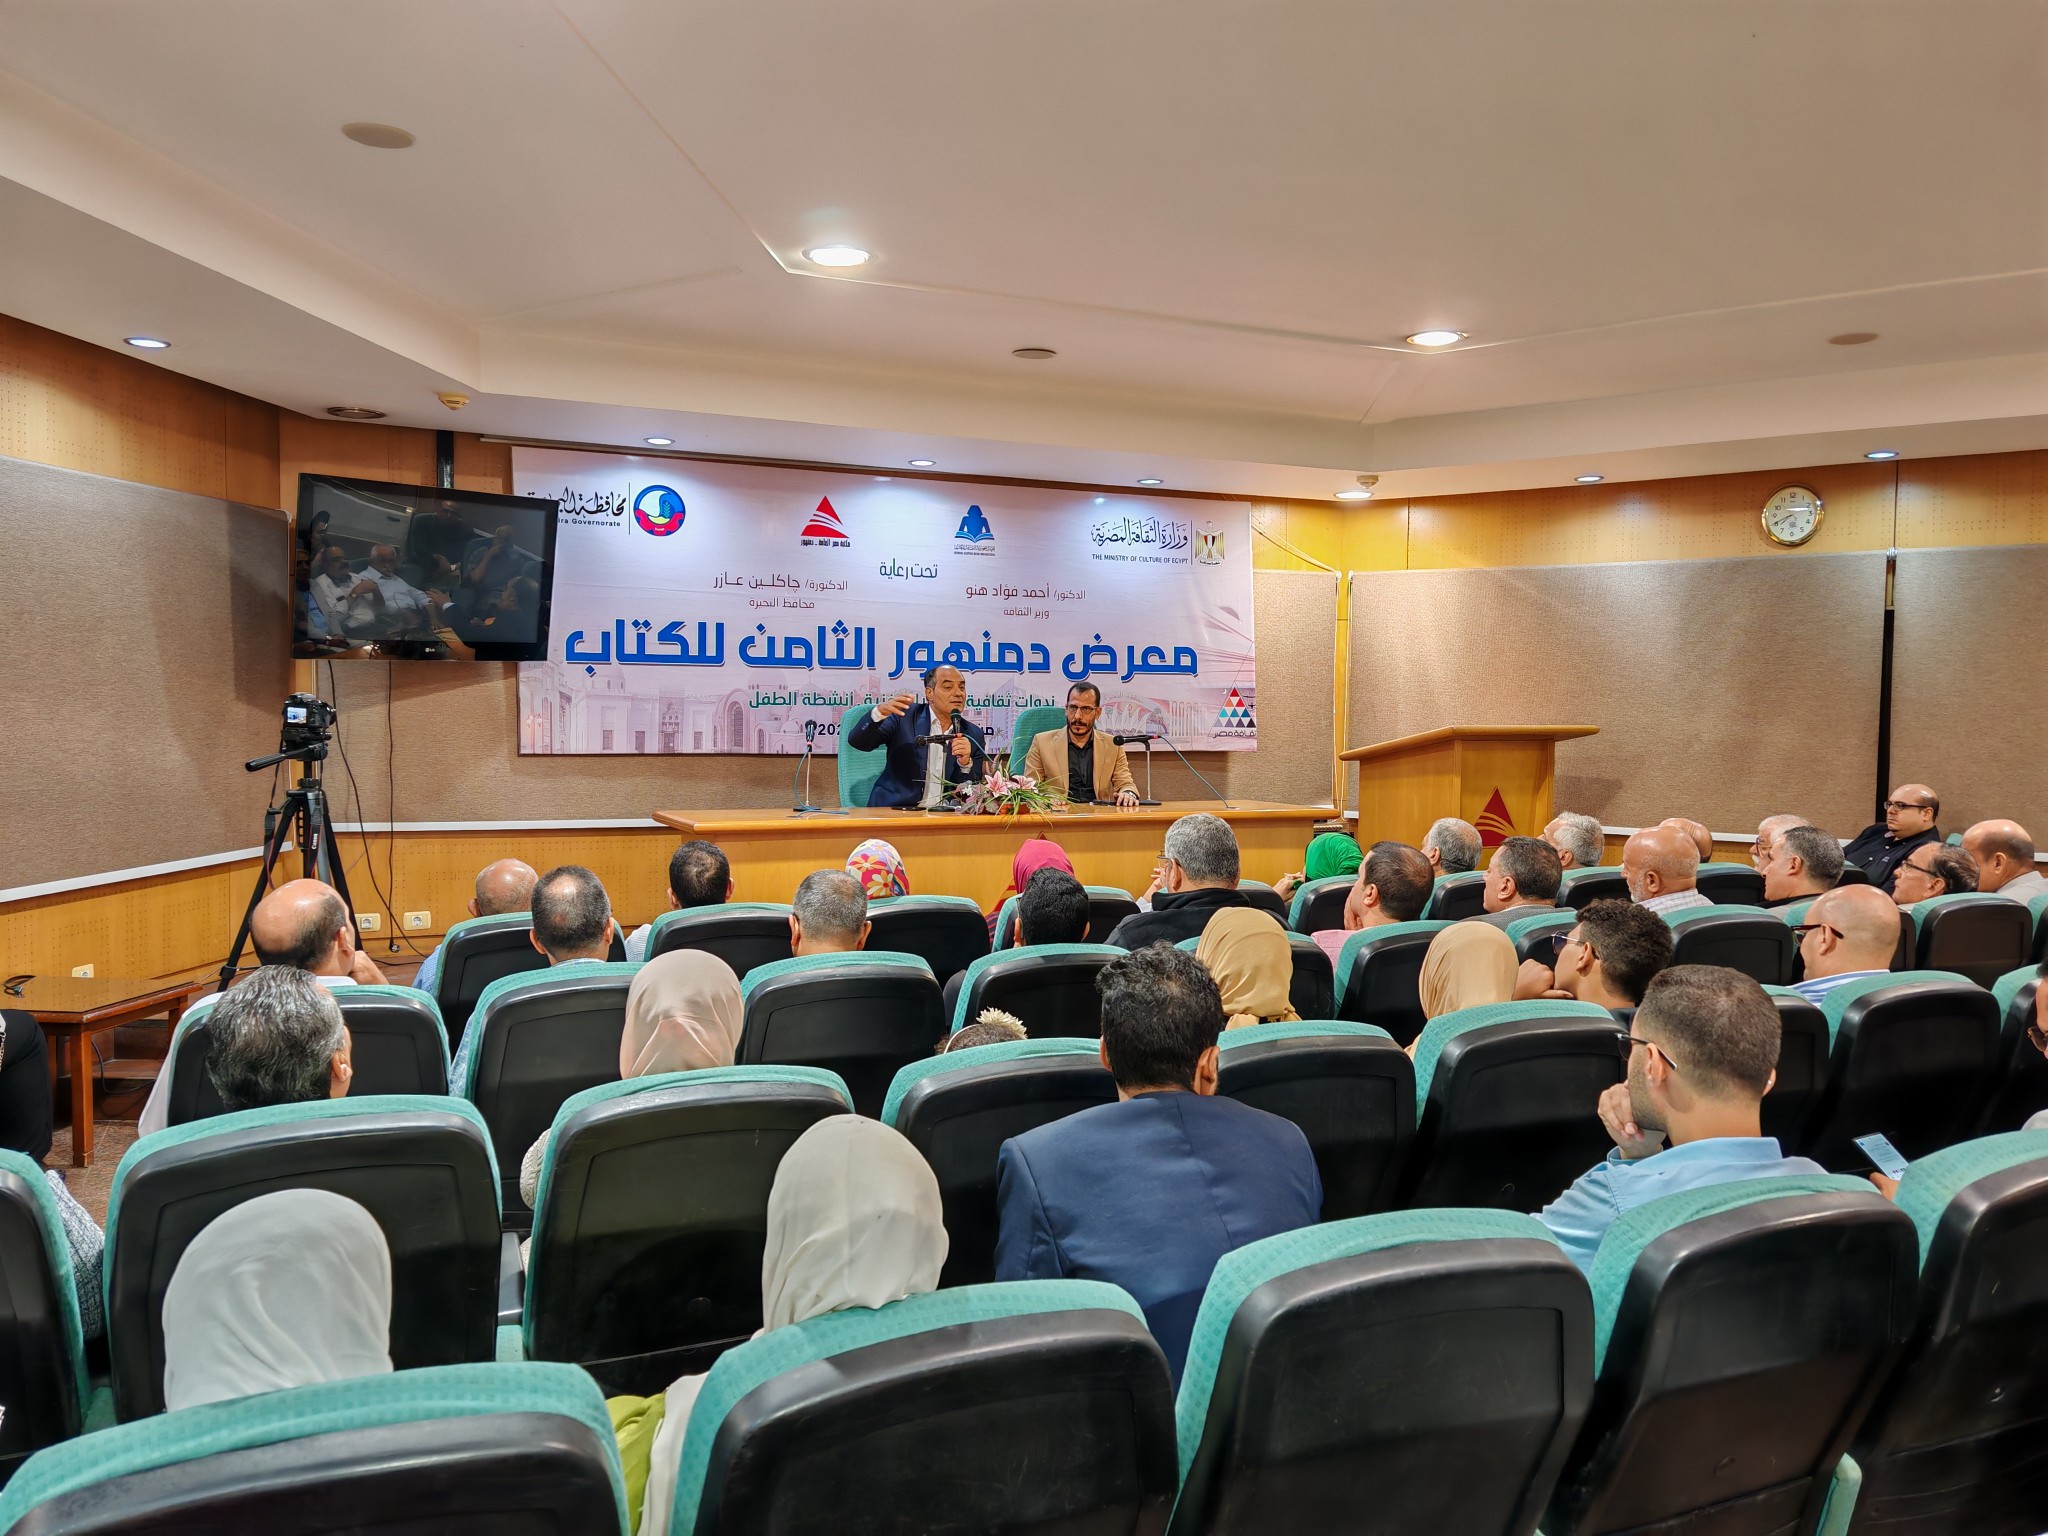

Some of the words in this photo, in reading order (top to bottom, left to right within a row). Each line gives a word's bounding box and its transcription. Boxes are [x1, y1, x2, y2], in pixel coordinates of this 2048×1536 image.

[571, 517, 621, 527] Governorate
[1092, 553, 1103, 561] THE
[1104, 554, 1129, 562] MINISTRY
[879, 558, 910, 580] رعاية
[910, 562, 938, 579] تحت
[965, 584, 988, 599] هنو
[991, 583, 1018, 600] فؤاد
[1022, 582, 1050, 599] أحمد
[749, 597, 779, 609] البحيرة
[782, 597, 815, 609] محافظ
[1034, 608, 1050, 620] وزير
[565, 617, 726, 677] للكتاب
[738, 618, 877, 671] الثامن
[888, 629, 1051, 680] دمنهور
[1061, 632, 1199, 683] معرض
[749, 691, 797, 709] الطفل
[802, 690, 854, 706] أنشطة
[966, 692, 1011, 711] ثقافية
[1015, 695, 1055, 708] ندوات
